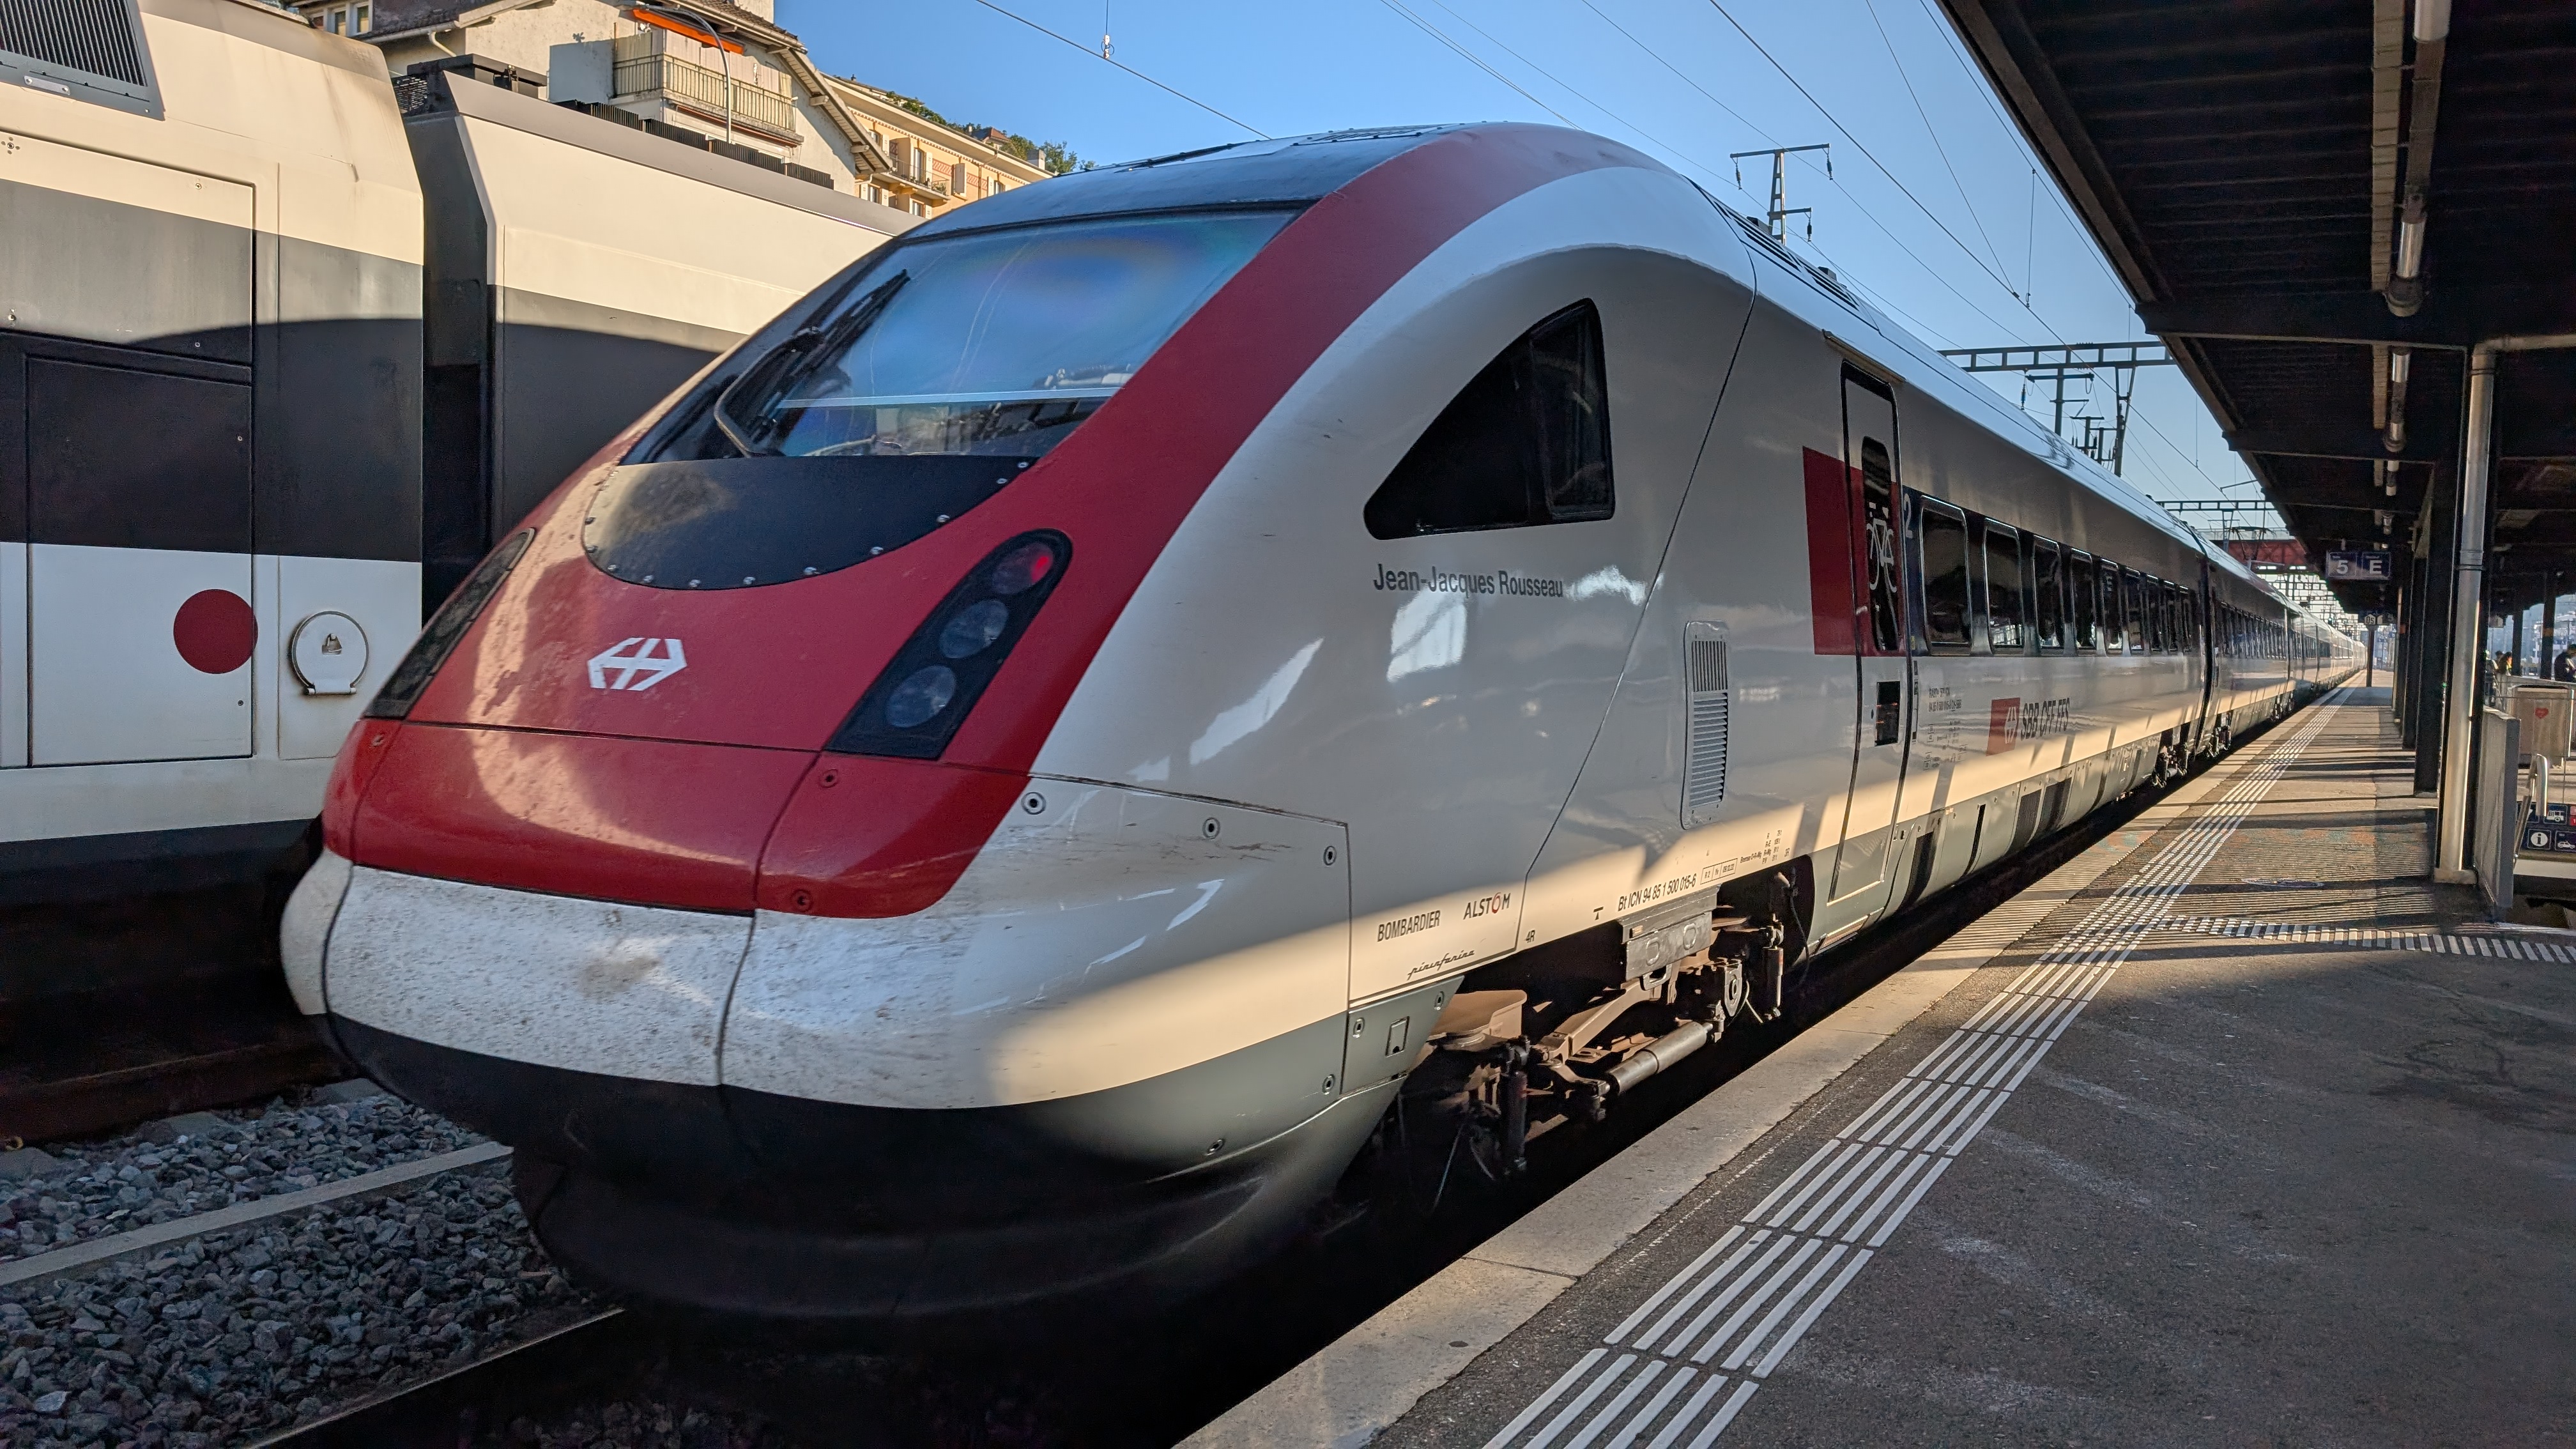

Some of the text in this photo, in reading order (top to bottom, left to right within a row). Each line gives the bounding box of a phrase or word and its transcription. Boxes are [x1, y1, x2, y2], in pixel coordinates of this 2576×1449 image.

[1903, 493, 1913, 539] 2
[1373, 563, 1563, 599] Jean-Jacques Rousseau
[2336, 560, 2349, 574] 5
[2369, 560, 2382, 574] E
[2020, 702, 2039, 741] SBB
[1463, 892, 1511, 920] ALSTOM
[1618, 873, 1697, 912] Bt ICN 94 85 1 500 015-6
[1377, 910, 1441, 942] BOMBARDIER
[1524, 930, 1535, 944] 4R
[1407, 949, 1475, 981] pininfarina
